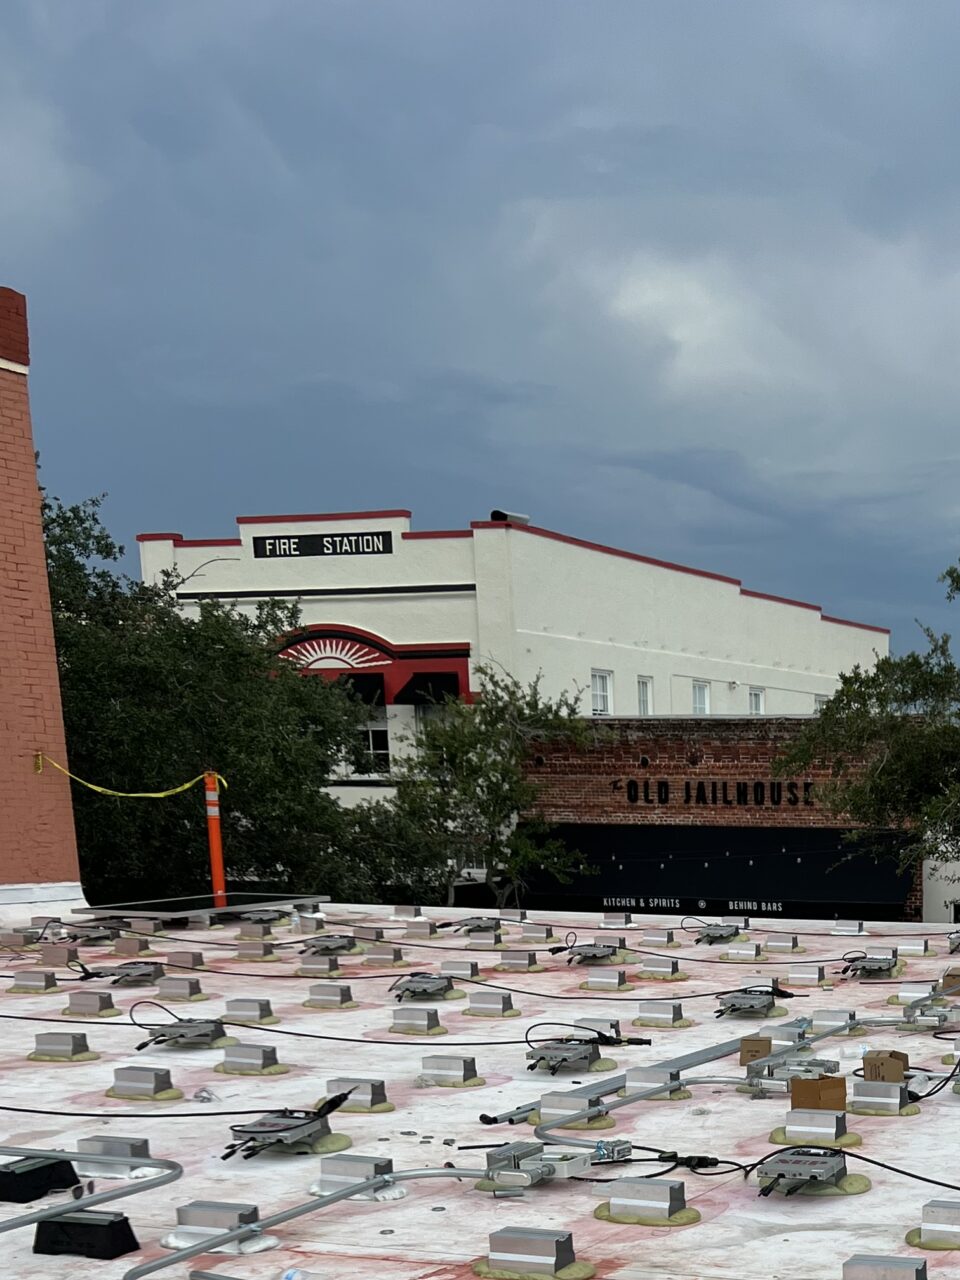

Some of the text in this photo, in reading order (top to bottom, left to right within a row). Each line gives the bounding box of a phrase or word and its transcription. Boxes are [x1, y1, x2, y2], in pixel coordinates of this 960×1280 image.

[265, 535, 383, 556] FIRE STATION
[627, 779, 669, 805] OLD
[684, 780, 815, 807] JAILHOUSE
[603, 897, 783, 912] KITCHEN & SPIRITS BEHIND BARS
